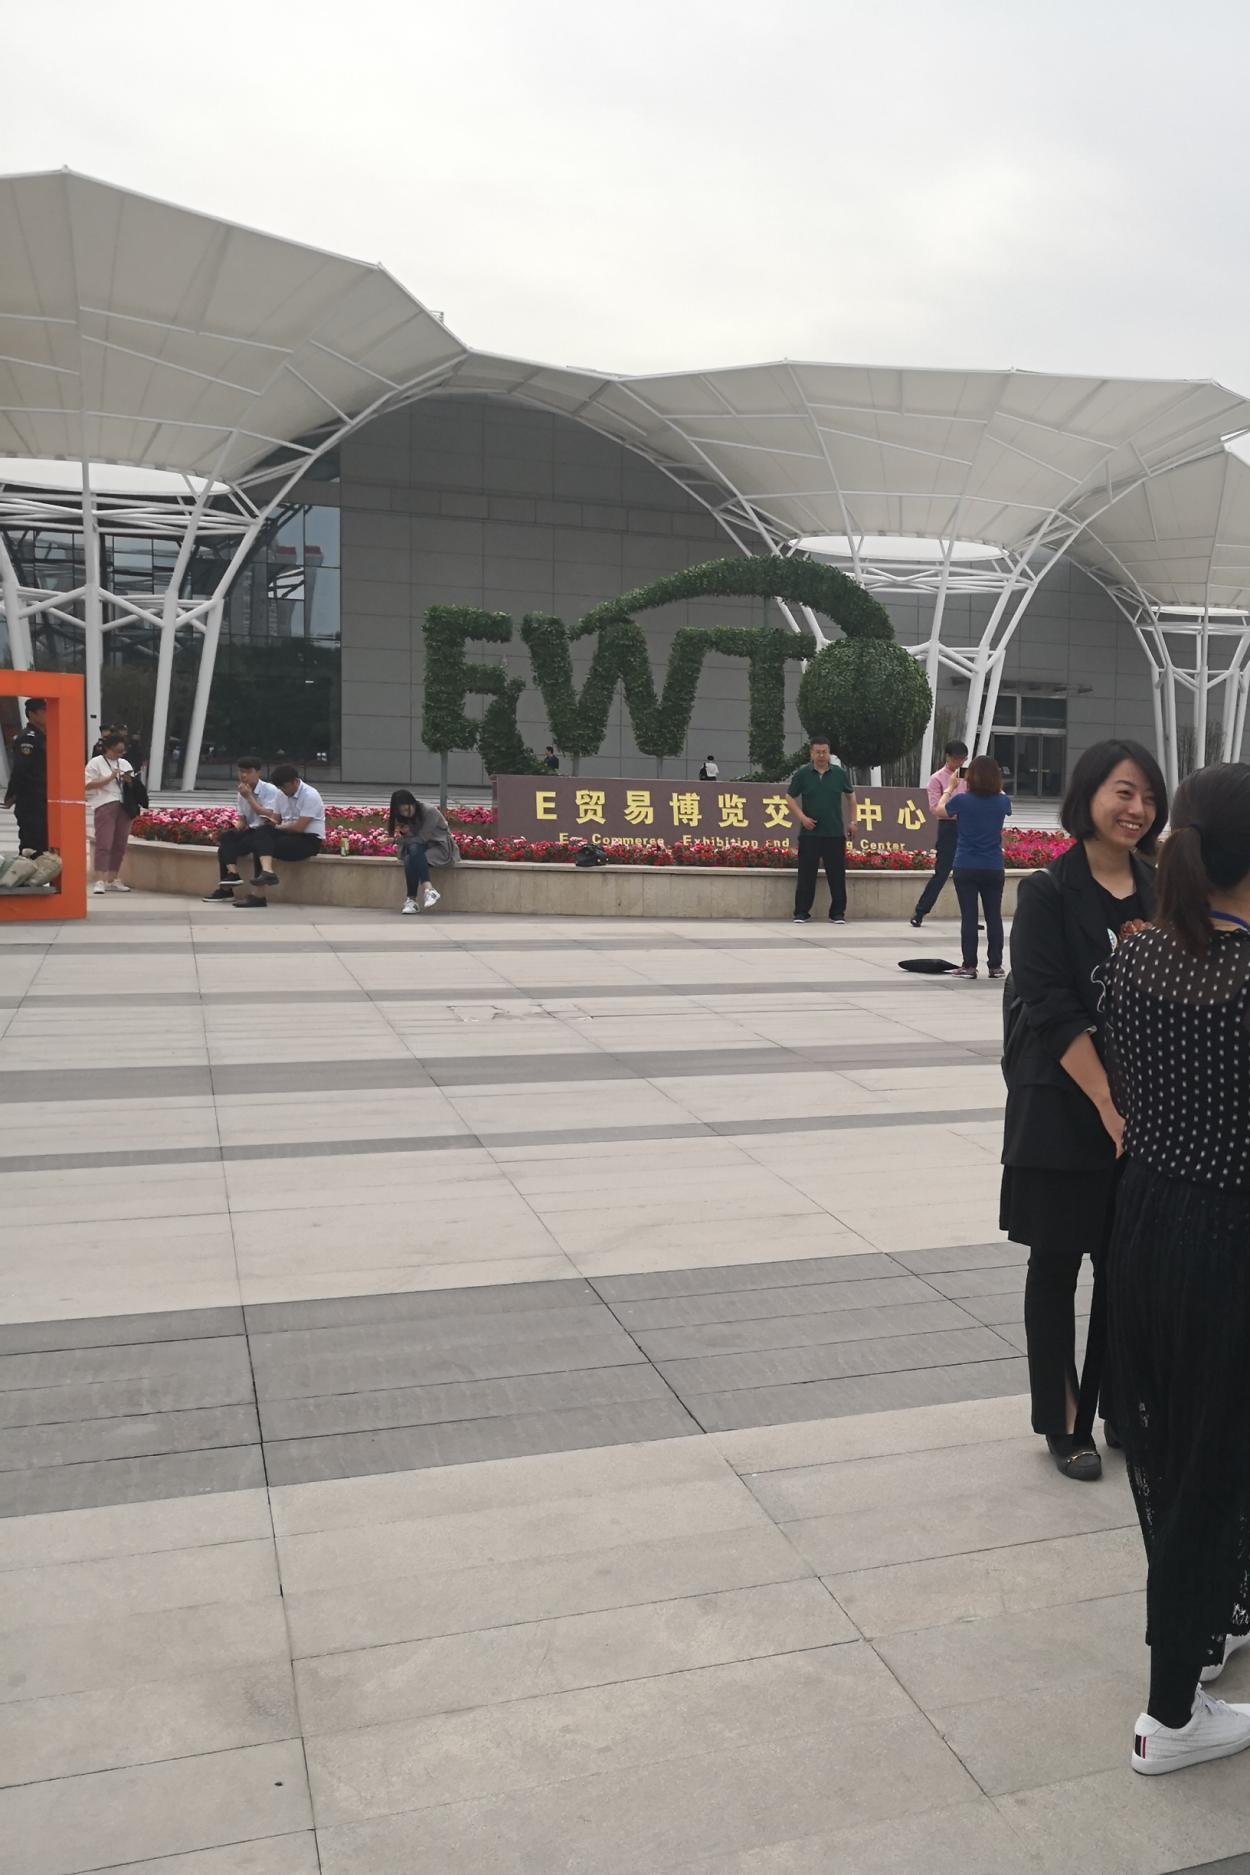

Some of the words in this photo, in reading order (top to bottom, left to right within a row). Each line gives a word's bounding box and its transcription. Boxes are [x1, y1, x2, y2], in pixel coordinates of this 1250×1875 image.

[535, 789, 926, 832] E贸易博览交中心
[860, 839, 906, 851] Center
